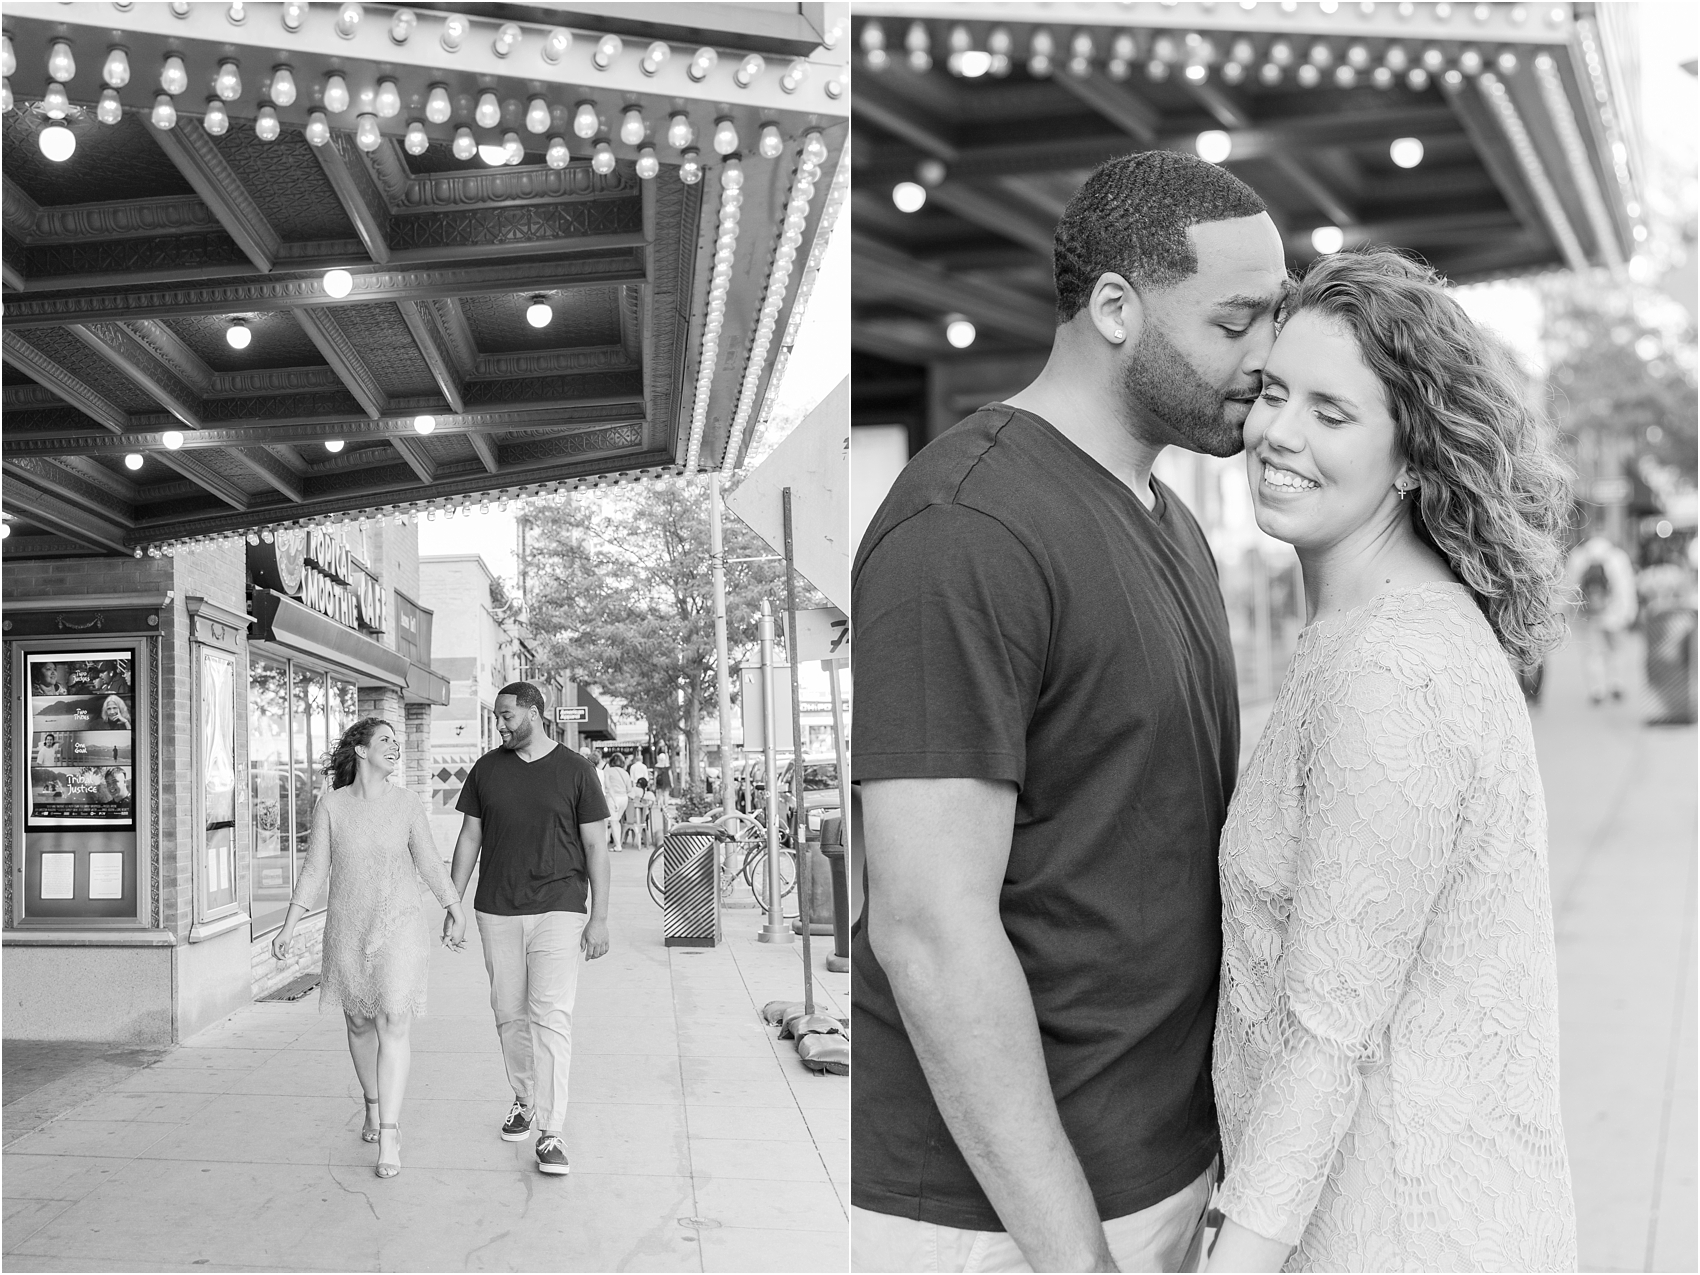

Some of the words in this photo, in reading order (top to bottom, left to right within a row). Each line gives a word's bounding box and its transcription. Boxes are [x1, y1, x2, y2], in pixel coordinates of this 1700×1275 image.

[302, 565, 359, 631] SMOOTHIE
[66, 774, 94, 784] Tribal
[66, 783, 98, 796] Justice
